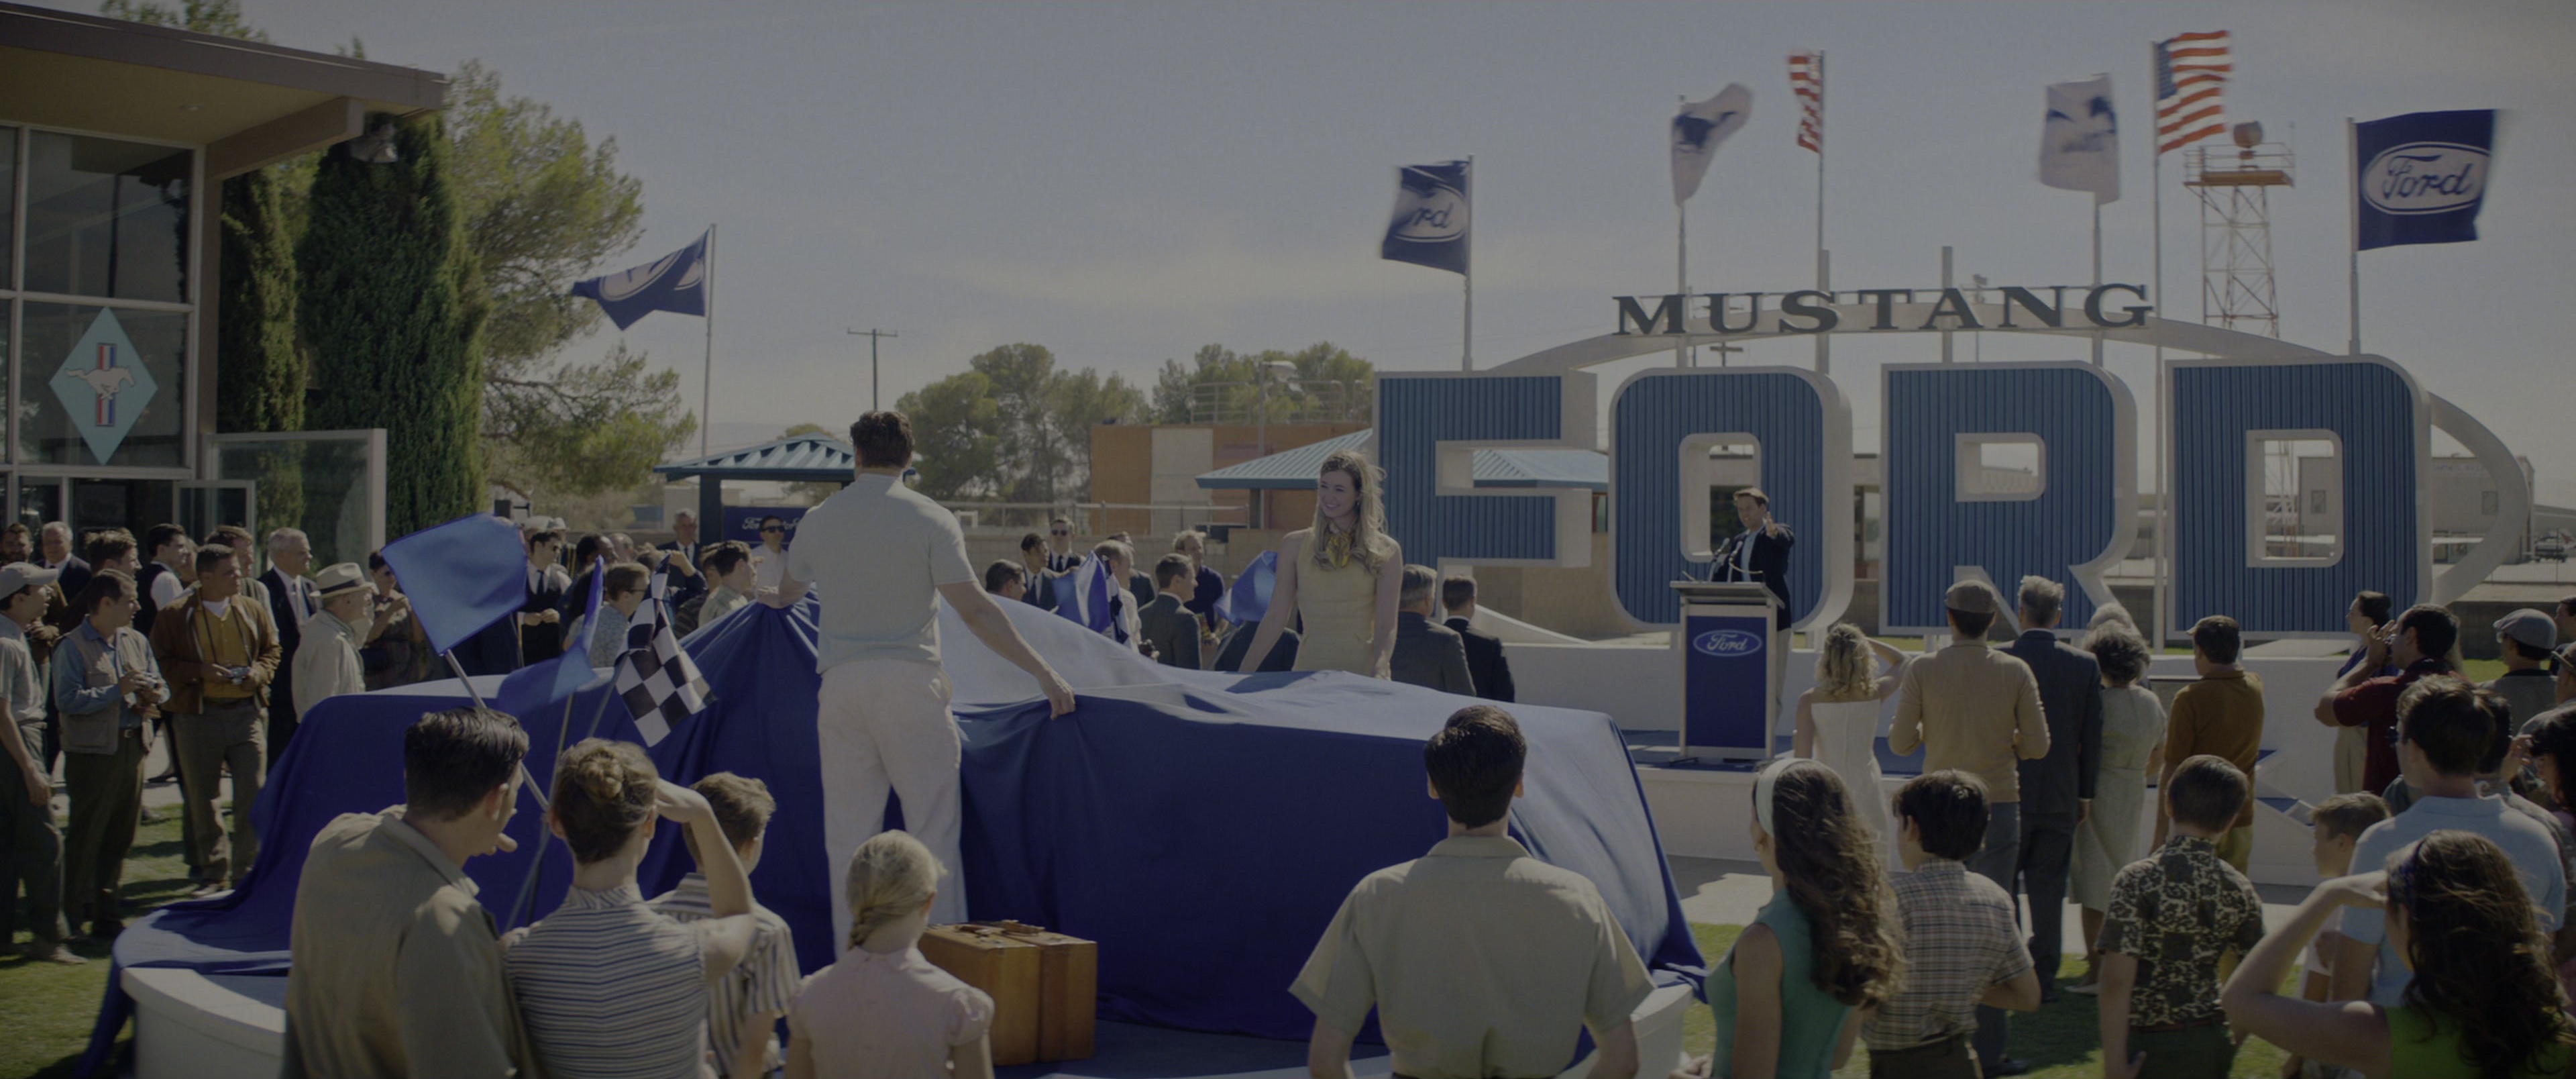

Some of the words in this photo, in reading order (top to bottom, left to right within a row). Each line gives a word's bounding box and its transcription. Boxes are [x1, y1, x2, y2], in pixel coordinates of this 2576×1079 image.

[2382, 154, 2474, 200] Ford
[1611, 283, 2153, 336] MUSTANG
[1373, 354, 2432, 639] FORD
[1707, 633, 1748, 651] Ford
